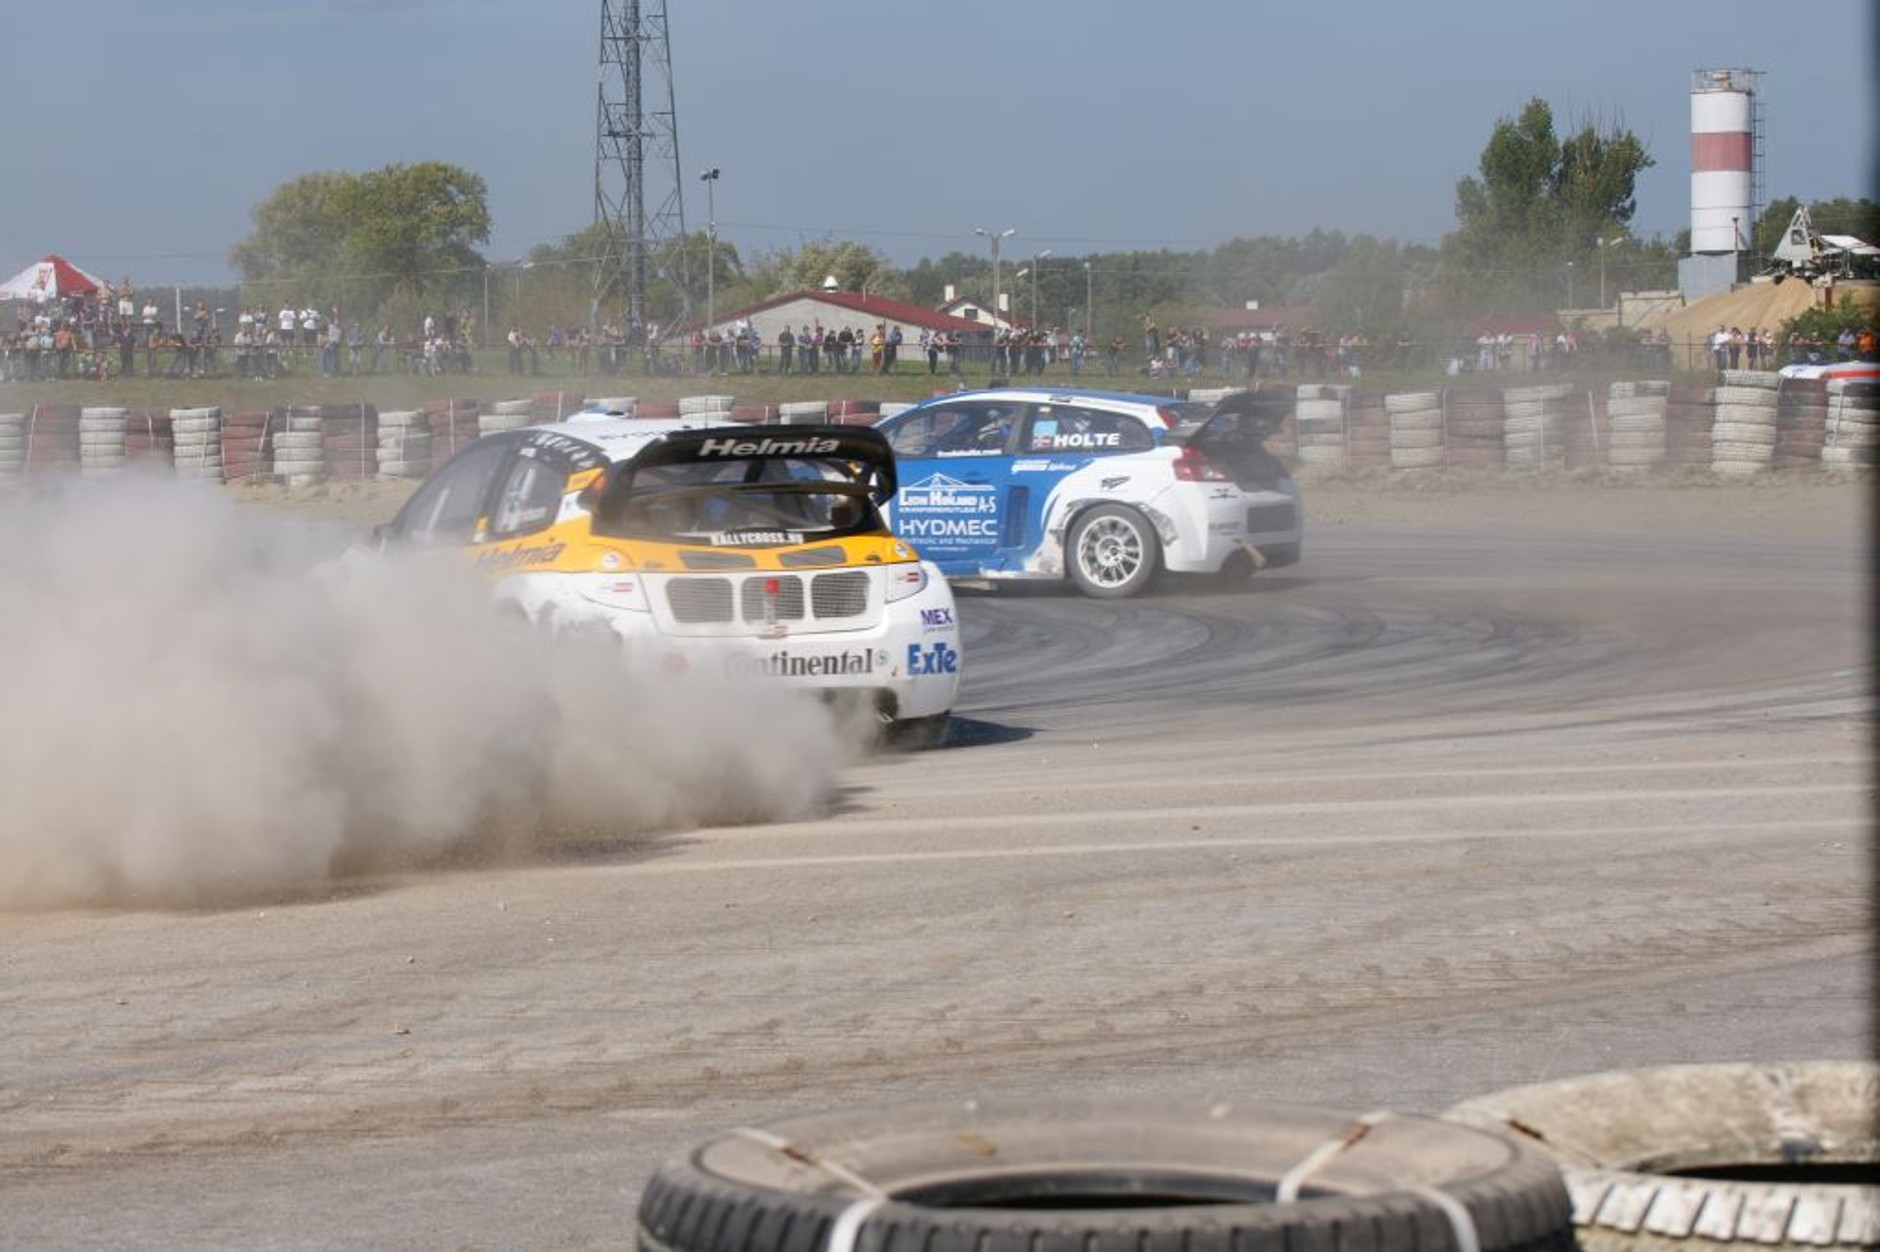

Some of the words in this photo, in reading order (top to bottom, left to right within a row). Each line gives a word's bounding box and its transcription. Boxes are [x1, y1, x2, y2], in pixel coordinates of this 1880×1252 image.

[698, 437, 841, 457] Helmia
[1053, 433, 1120, 447] HOLTE
[899, 519, 998, 536] HYDMEC
[920, 608, 952, 626] MEX
[907, 643, 957, 676] ExTe
